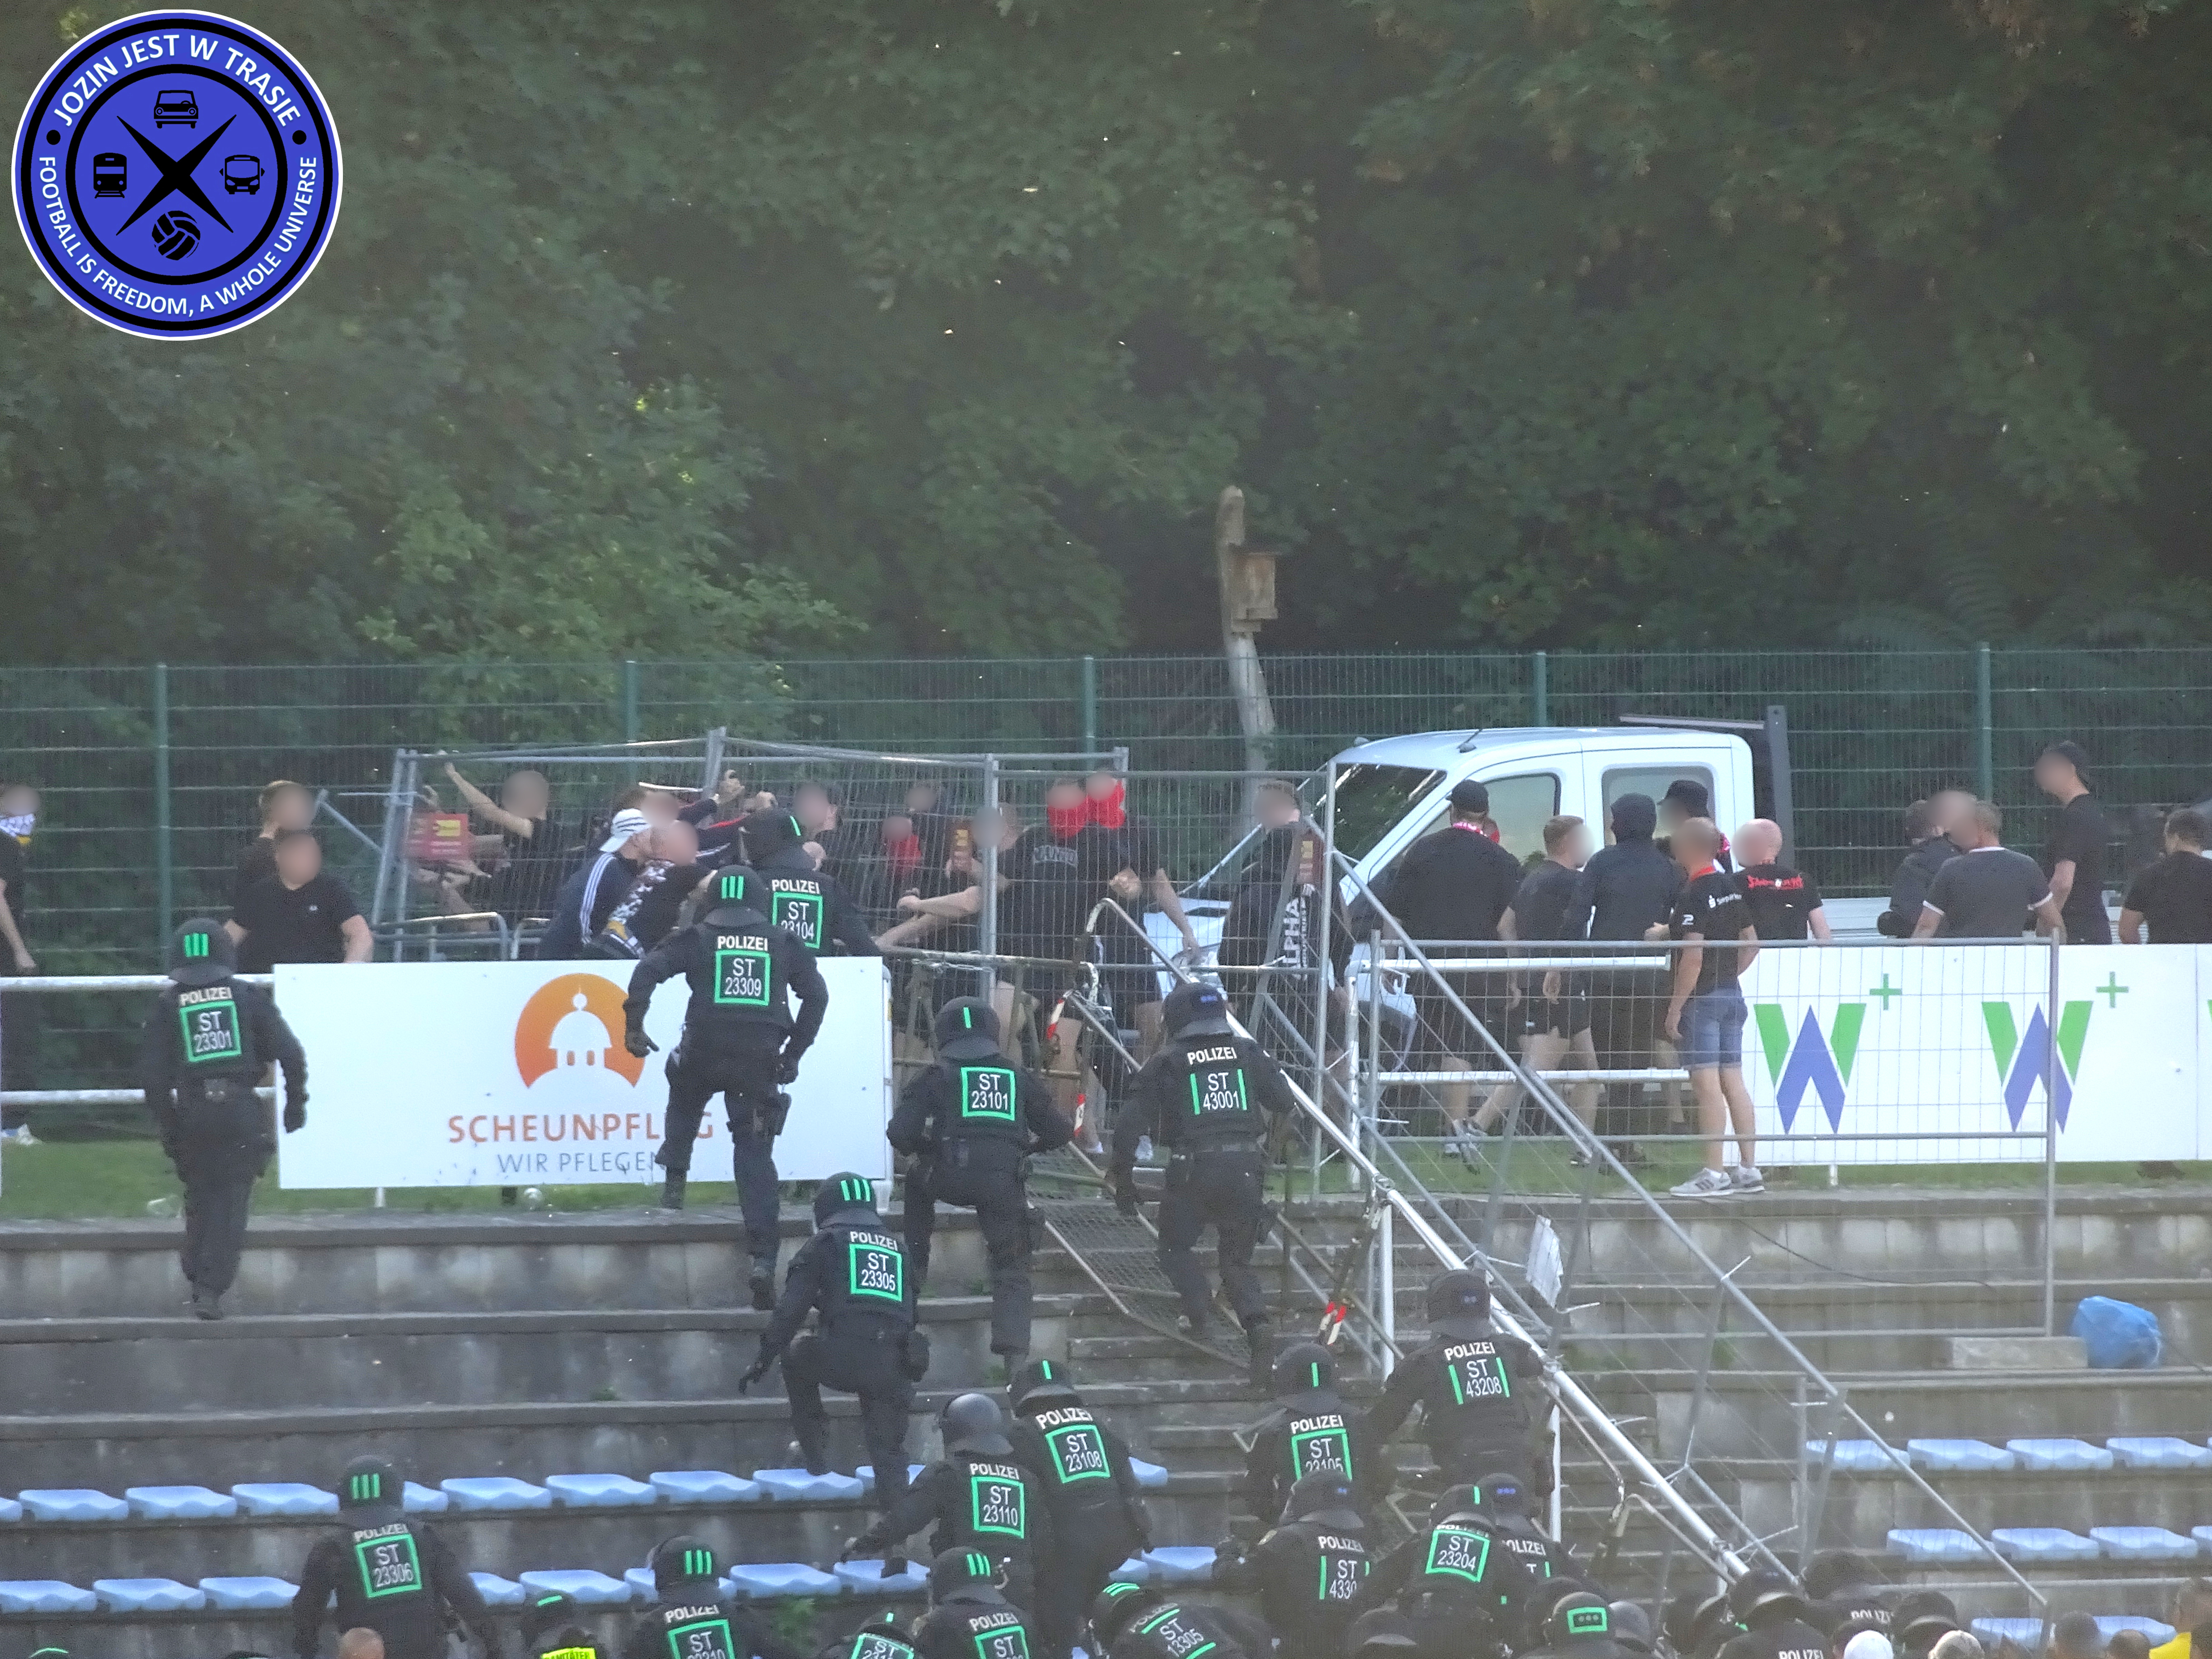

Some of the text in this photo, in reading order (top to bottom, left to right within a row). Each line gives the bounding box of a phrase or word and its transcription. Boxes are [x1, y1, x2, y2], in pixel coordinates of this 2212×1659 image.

[772, 879, 820, 894] POLIZEI
[788, 901, 809, 920] ST
[717, 936, 768, 951] POLIZEI
[732, 958, 755, 977] ST
[179, 987, 232, 1006] POLIZEI
[725, 977, 761, 997] 23309
[199, 1011, 222, 1031] ST
[194, 1030, 232, 1053] 23301
[1187, 1047, 1237, 1065] POLIZEI
[979, 1074, 1001, 1091] ST
[1208, 1073, 1230, 1091] ST
[972, 1090, 1008, 1111] 23101
[1203, 1090, 1239, 1111] 43001
[448, 1112, 713, 1143] SCHEUNPFLG
[497, 1153, 548, 1174] WIR
[850, 1231, 898, 1251] POLIZEI
[867, 1253, 890, 1271] ST
[861, 1270, 895, 1291] 23305
[1444, 1342, 1495, 1361] POLIZEI
[1467, 1359, 1487, 1378] ST
[1466, 1376, 1502, 1397] 43208
[1036, 1407, 1094, 1429] POLIZEI
[1290, 1415, 1344, 1434] POLIZEI
[1066, 1434, 1088, 1452] ST
[1310, 1438, 1332, 1458] ST
[1065, 1451, 1103, 1472] 23108
[970, 1463, 1020, 1481] POLIZEI
[989, 1486, 1012, 1504] ST
[983, 1505, 1018, 1526] 23110
[354, 1523, 408, 1542] POLIZEI
[1318, 1536, 1364, 1552] POLIZEI
[1449, 1536, 1474, 1552] ST
[1502, 1539, 1546, 1556] OLIZEI
[375, 1544, 398, 1565] ST
[1437, 1550, 1476, 1571] 23204
[374, 1563, 413, 1587] 23306
[1337, 1559, 1357, 1579] ST
[969, 1613, 1019, 1631] POLIZEI
[1160, 1617, 1184, 1640] ST
[689, 1631, 712, 1652] ST
[875, 1641, 900, 1657] ST
[994, 1636, 1014, 1657] ST
[1167, 1628, 1204, 1657] 13305
